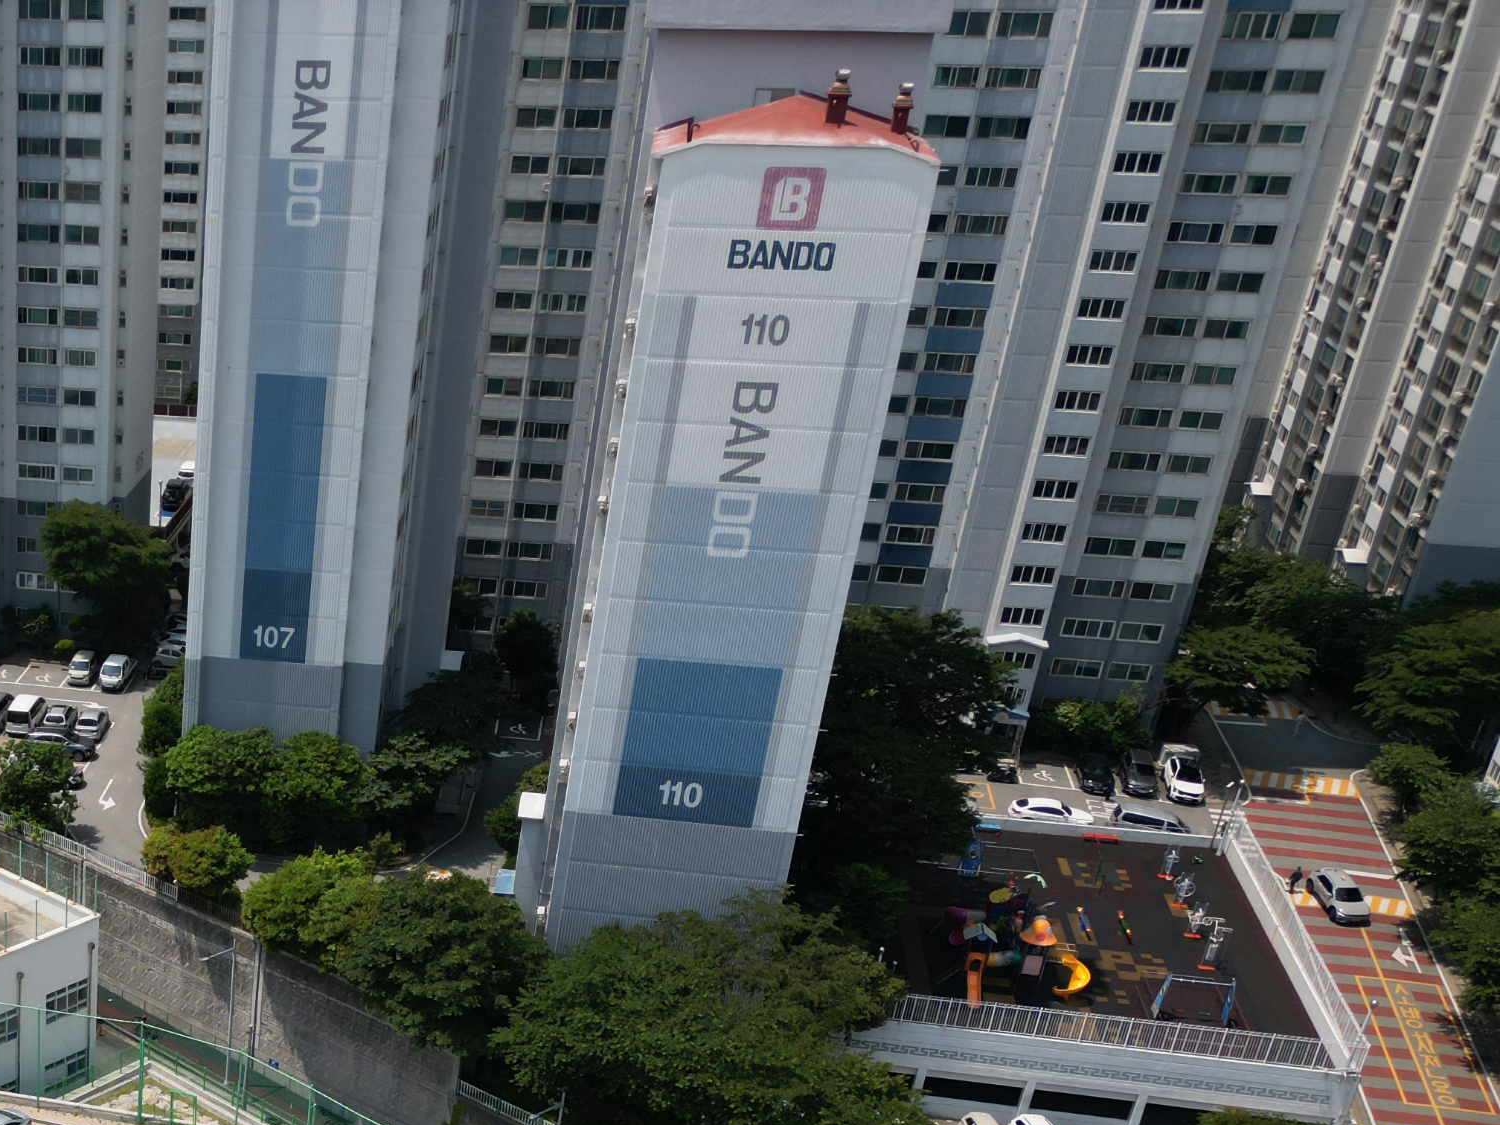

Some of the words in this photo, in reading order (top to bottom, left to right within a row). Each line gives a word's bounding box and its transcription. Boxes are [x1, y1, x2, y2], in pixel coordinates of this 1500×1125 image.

[286, 60, 331, 227] BANDO
[727, 239, 836, 271] BANDO
[741, 313, 790, 347] 110
[707, 380, 779, 558] BANDO
[253, 624, 296, 649] 107
[659, 780, 703, 808] 110
[1394, 983, 1456, 1105] 소방차전용
